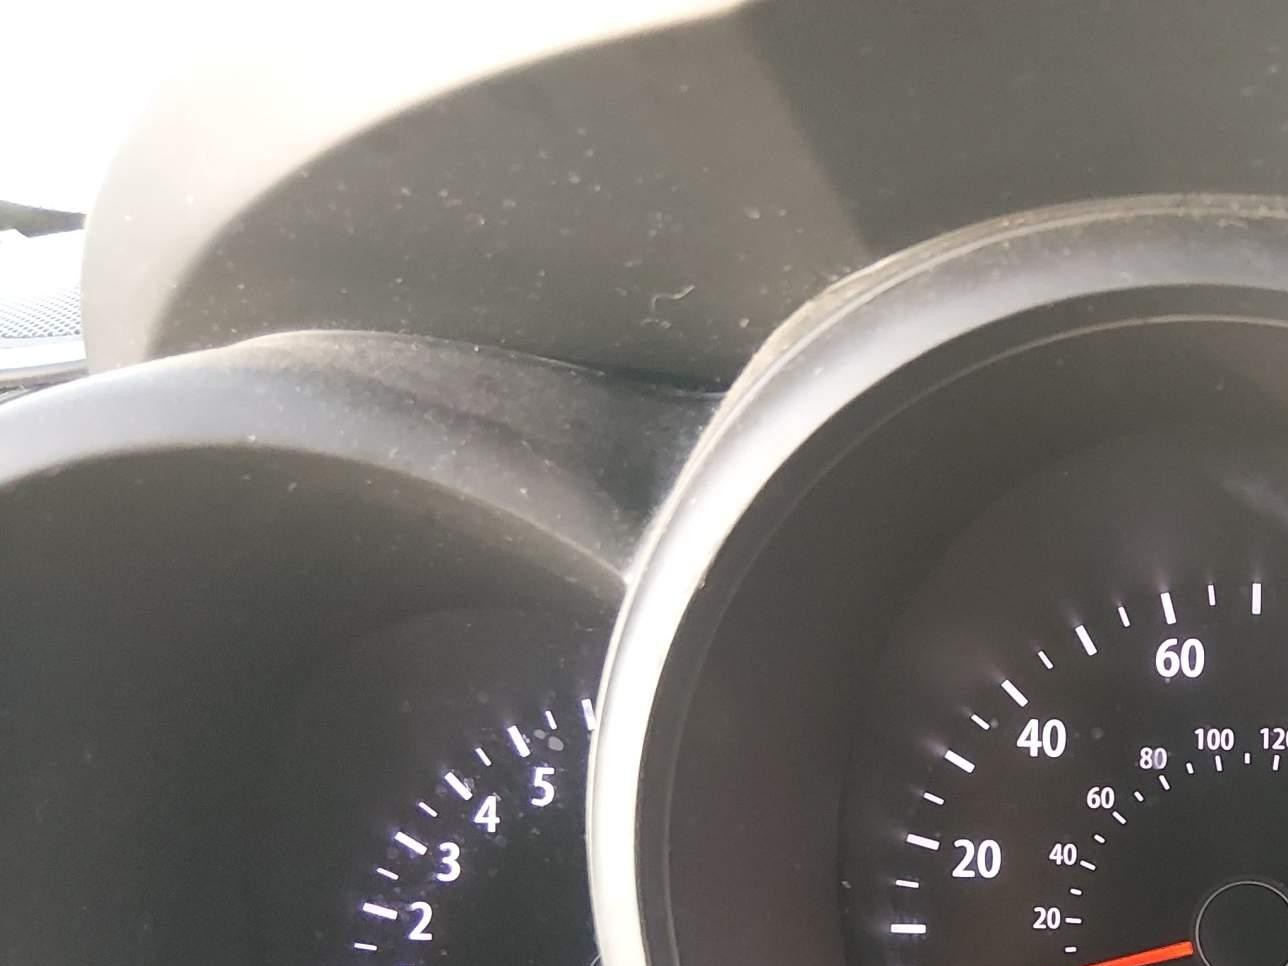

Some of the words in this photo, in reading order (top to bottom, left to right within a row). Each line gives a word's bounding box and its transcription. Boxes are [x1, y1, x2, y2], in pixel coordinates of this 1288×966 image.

[1156, 639, 1204, 682] 60
[1017, 719, 1066, 757] 40
[1195, 729, 1234, 750] 100
[1140, 747, 1167, 769] 80
[531, 765, 556, 807] 5
[1087, 787, 1114, 808] 60
[473, 797, 501, 832] 4
[434, 842, 460, 881] 3
[952, 839, 1001, 878] 20
[1049, 844, 1077, 865] 40
[407, 902, 432, 940] 2
[1033, 907, 1060, 929] 20
